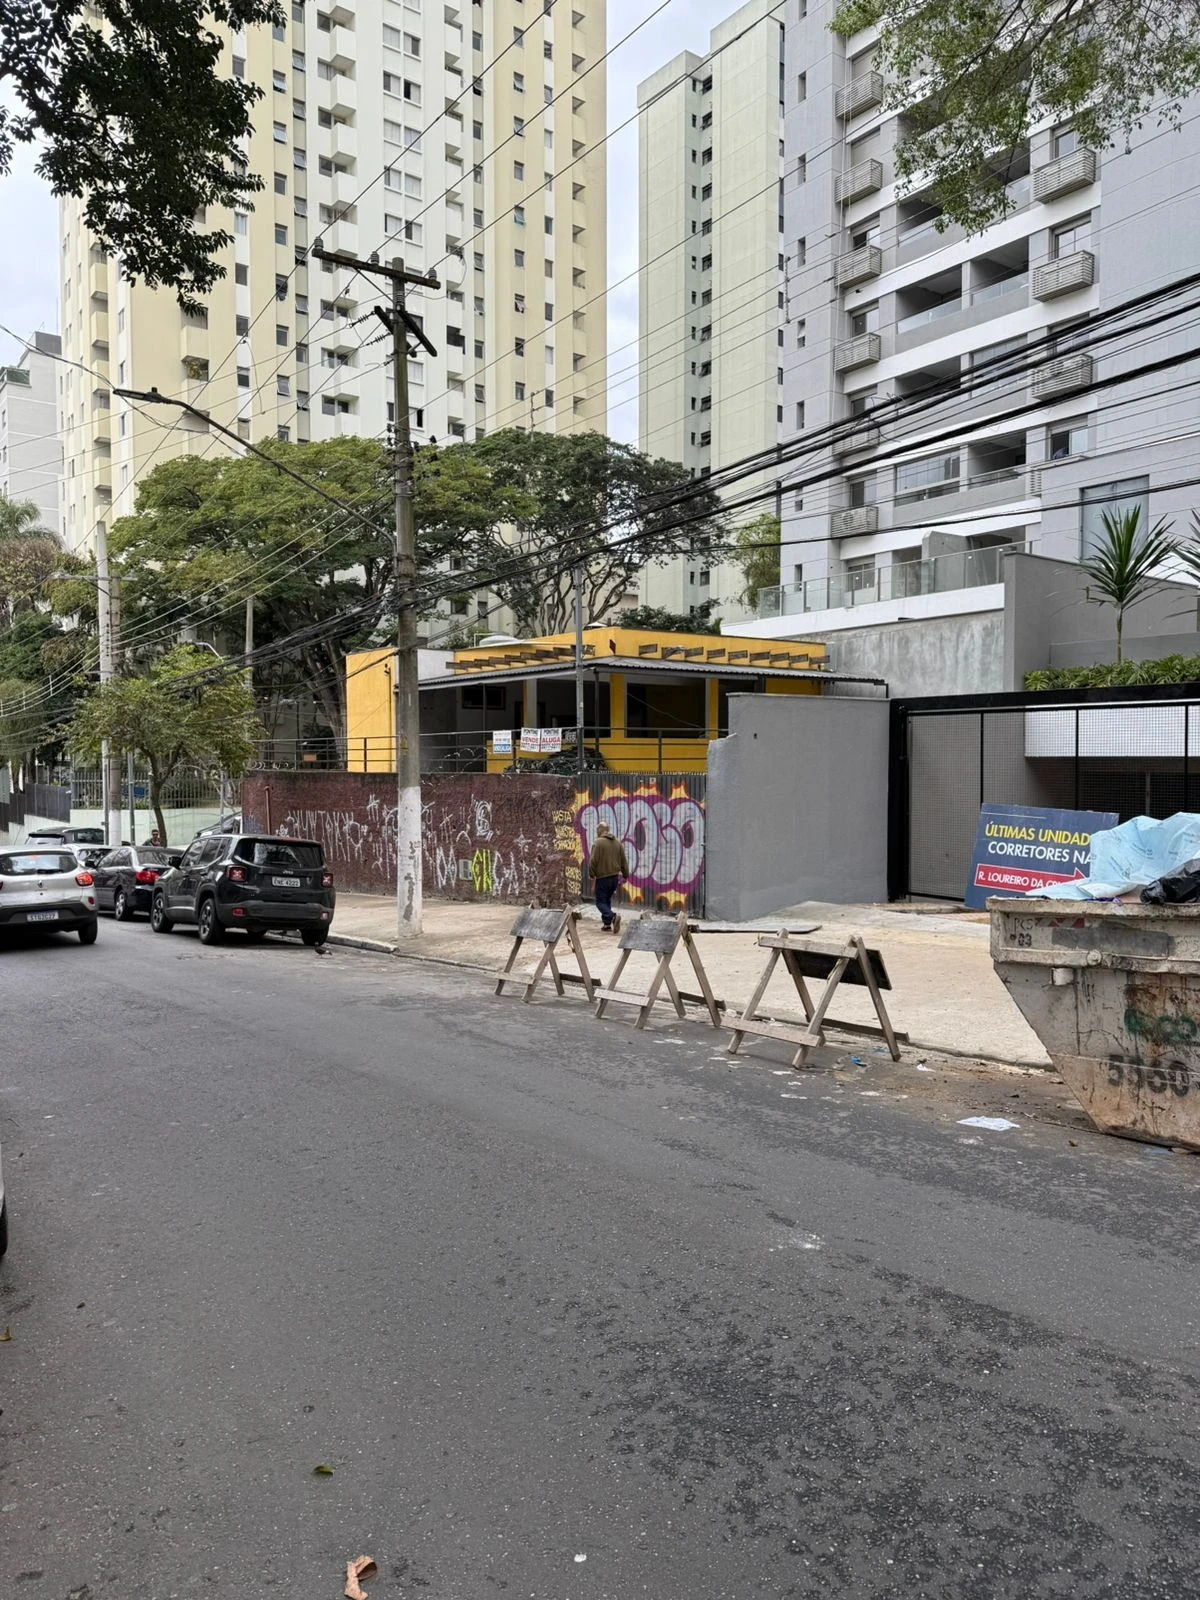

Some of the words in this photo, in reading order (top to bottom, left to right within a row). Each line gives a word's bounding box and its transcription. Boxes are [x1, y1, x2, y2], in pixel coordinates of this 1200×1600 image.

[985, 821, 1035, 840] ÚLTIMAS
[1038, 828, 1090, 846] UNIDAD
[988, 841, 1070, 862] CORRETORES
[978, 871, 986, 880] R.
[988, 872, 1029, 886] LOUREIRO
[1031, 878, 1044, 888] DA
